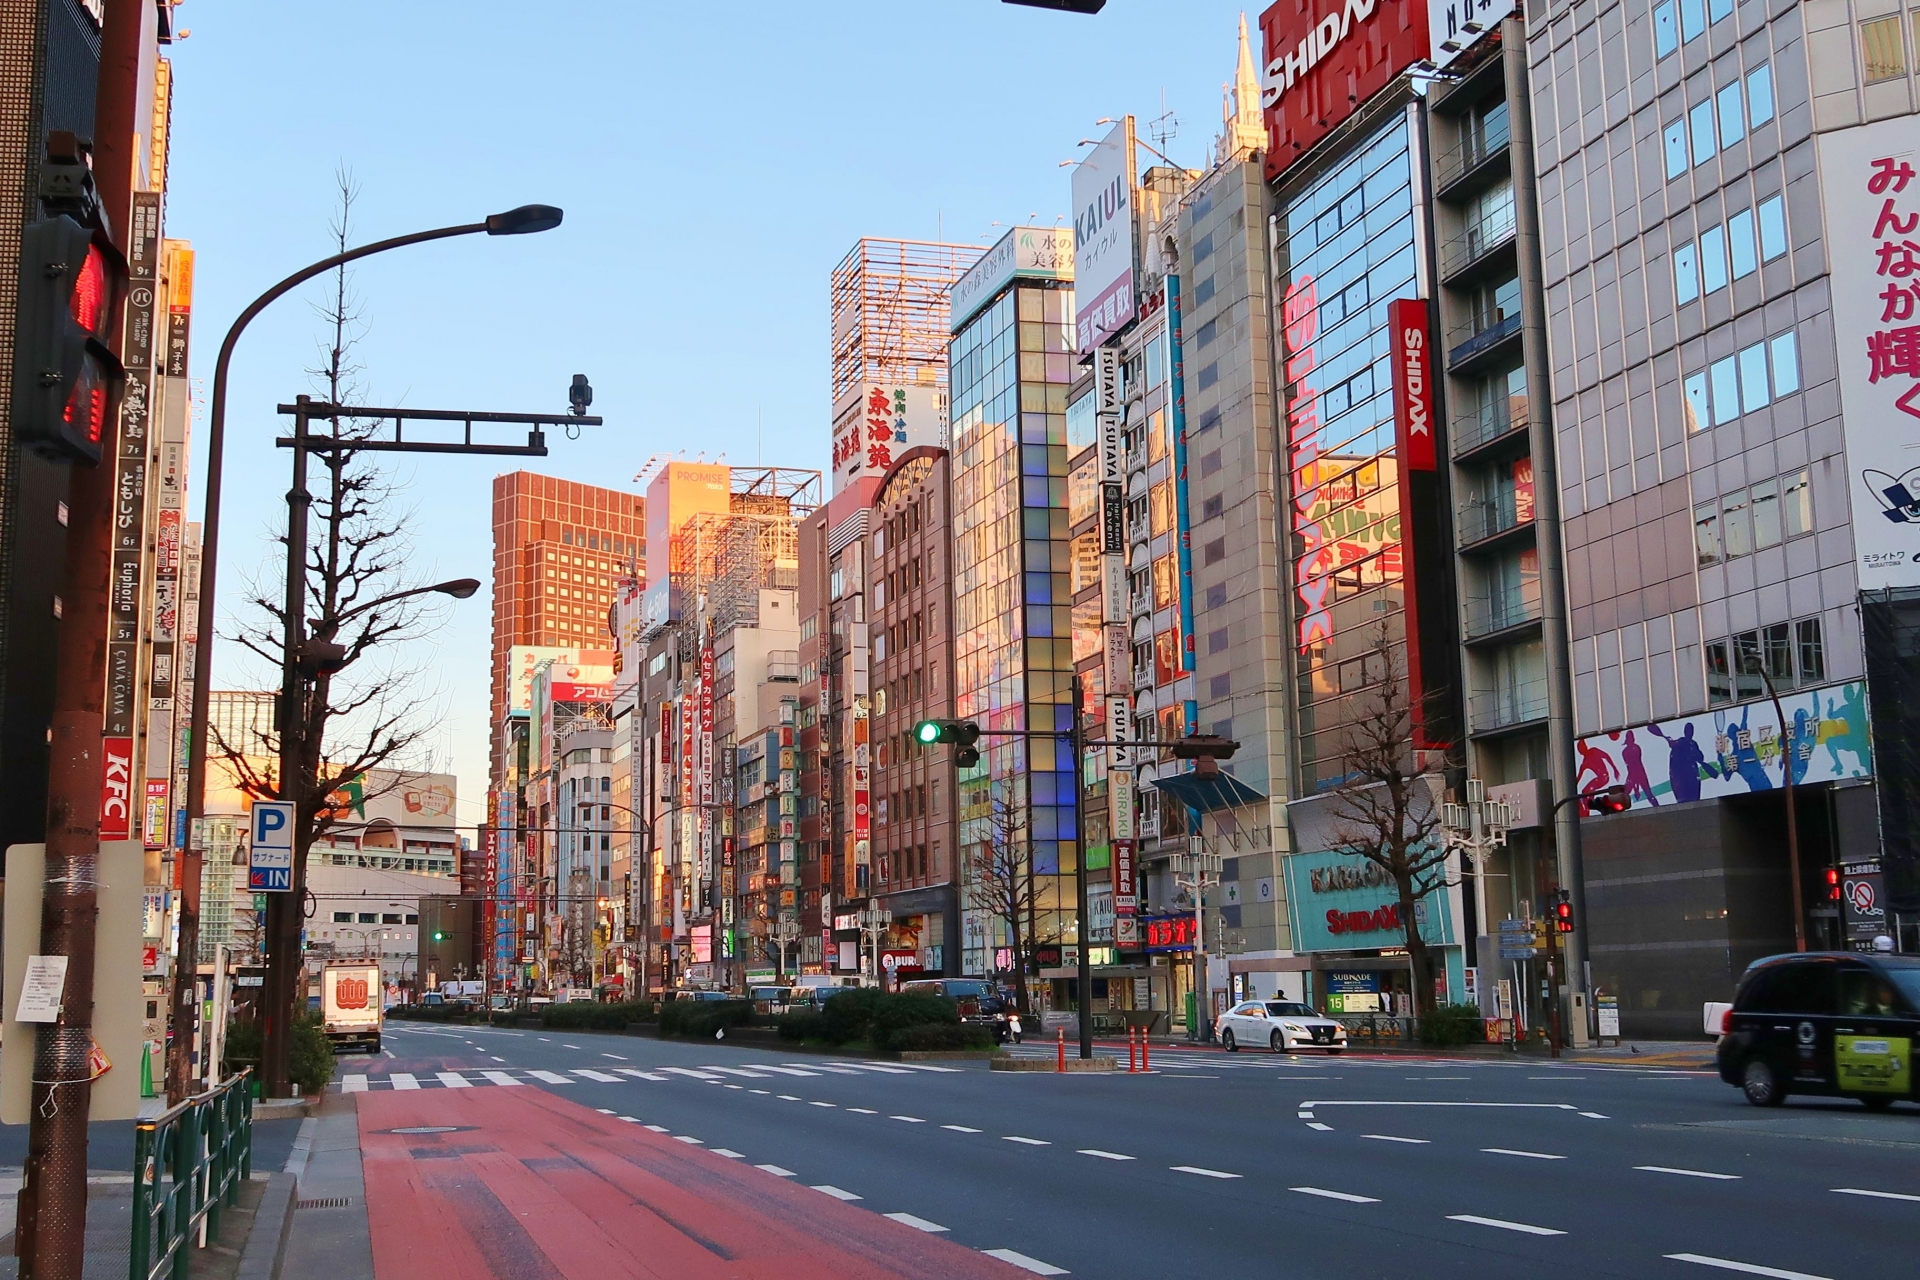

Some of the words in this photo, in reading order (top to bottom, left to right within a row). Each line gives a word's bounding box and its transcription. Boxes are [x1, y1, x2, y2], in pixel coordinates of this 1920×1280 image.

[1263, 0, 1394, 109] SHIDA
[1075, 174, 1127, 251] KAIUL
[1084, 227, 1118, 271] カイウル
[137, 266, 150, 275] 9F
[173, 315, 185, 326] 7F
[1077, 281, 1131, 349] 高価買取
[1103, 350, 1115, 409] TSUTAYA
[1404, 326, 1428, 437] SHIDAX
[865, 386, 894, 470] 東海苑
[127, 445, 140, 454] 7F
[1105, 419, 1117, 478] TSUTAYA
[1284, 274, 1334, 656] SHIDAX
[676, 470, 724, 485] PROMISE
[118, 471, 133, 529] ともしび
[122, 537, 136, 546] 6F
[1863, 551, 1905, 563] ミライトワ
[119, 562, 138, 611] Euphoria
[118, 629, 131, 639] 5F
[523, 652, 536, 710] カラオケ
[573, 686, 611, 698] アコム
[153, 699, 169, 709] 2F
[683, 698, 692, 741] カラオケ
[702, 685, 712, 728] カラオケ
[113, 724, 126, 733] 4F
[1114, 702, 1126, 763] TSUTAYA
[682, 755, 692, 787] パセラ
[1726, 742, 1812, 772] 第一分舎
[104, 752, 129, 820] KFC
[147, 784, 166, 793] B1F
[258, 809, 285, 842] P
[253, 853, 289, 862] サブナード
[487, 833, 496, 879] エスパス
[1118, 846, 1131, 894] 高価買取
[269, 870, 289, 886] IN
[1326, 904, 1401, 935] SHIDAX
[1332, 973, 1372, 982] SUBNADE
[1329, 998, 1342, 1009] 15
